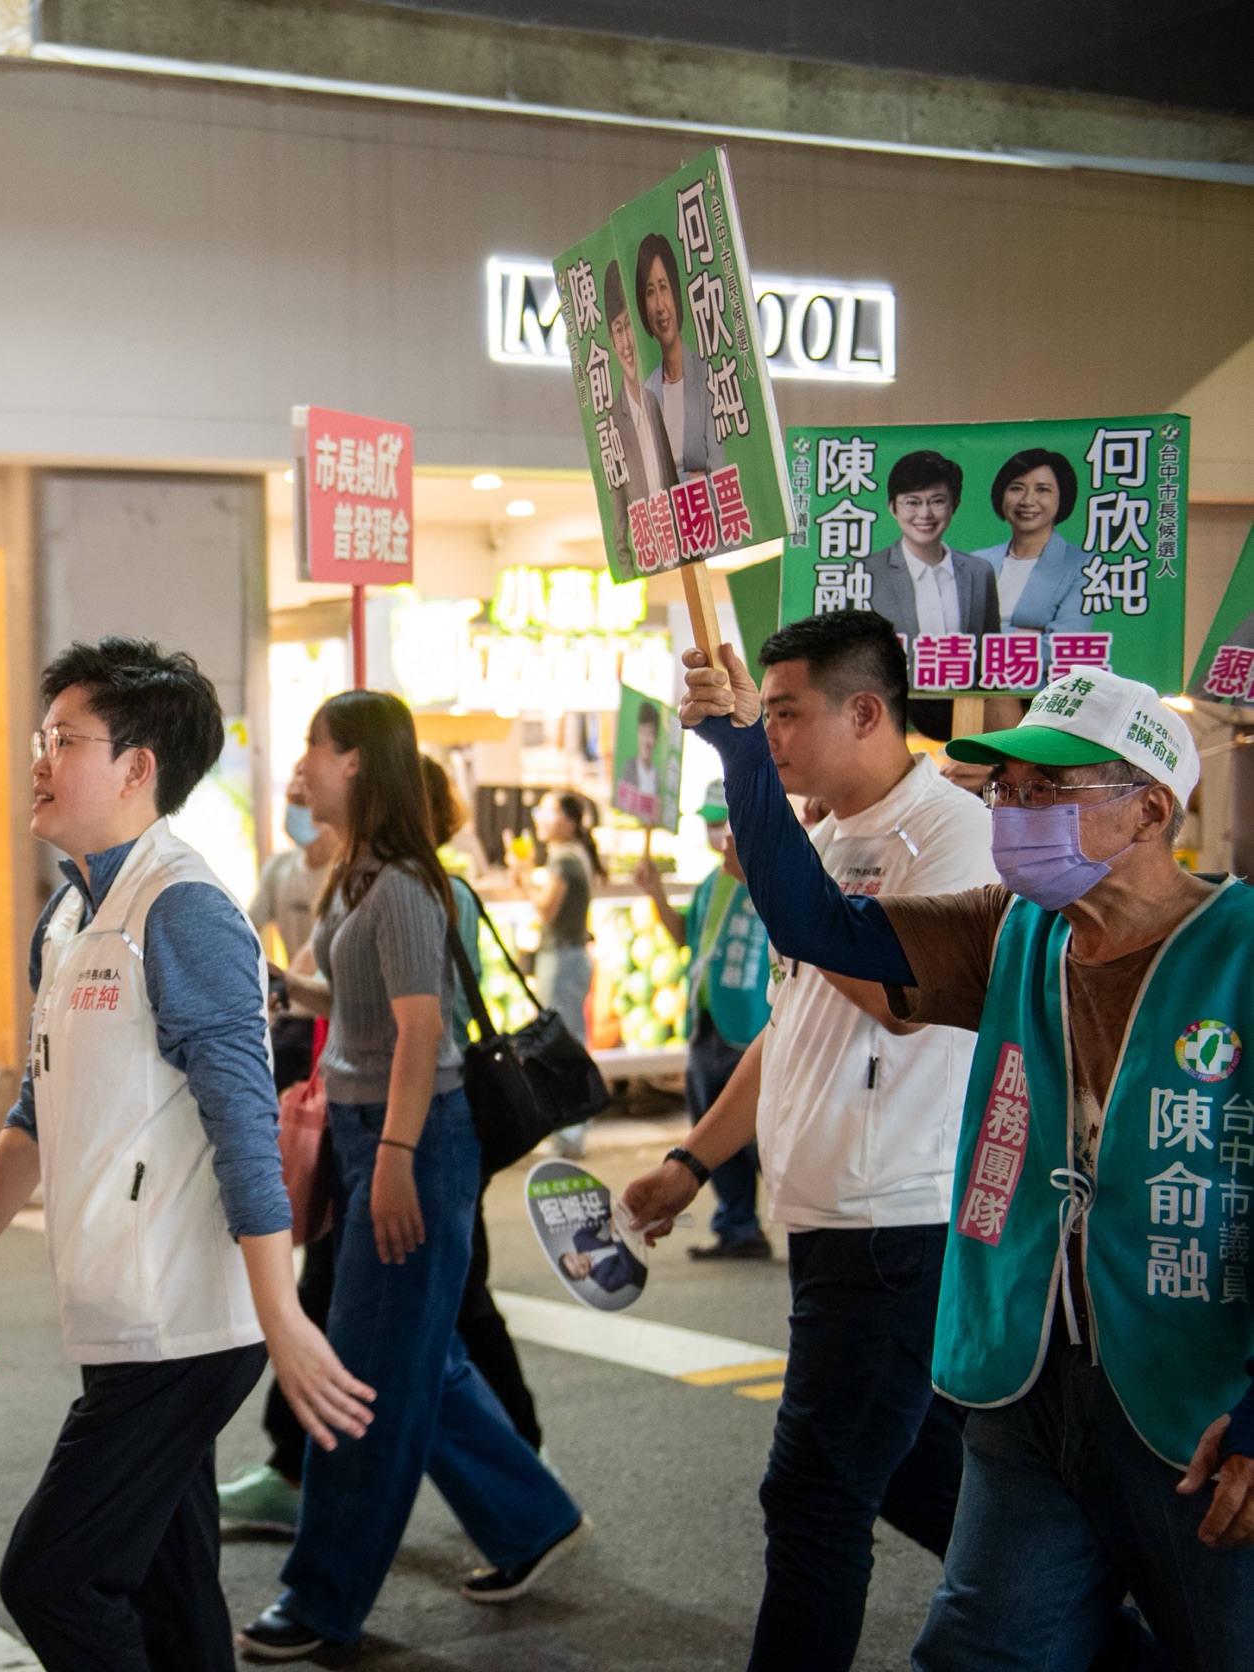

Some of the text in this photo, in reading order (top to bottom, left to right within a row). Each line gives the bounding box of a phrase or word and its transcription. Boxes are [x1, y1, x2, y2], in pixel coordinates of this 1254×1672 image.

[567, 257, 630, 492] 陳俞融
[676, 179, 750, 443] 何欣純
[314, 432, 404, 500] 市長換欣
[333, 502, 410, 564] 普發現金
[628, 463, 752, 573] 懇請賜票
[814, 436, 878, 617] 陳俞融
[1082, 427, 1152, 615] 何欣純
[1156, 444, 1180, 579] 台中市長候選人
[898, 632, 1114, 691] 請賜票
[1204, 645, 1254, 702] 懇
[1134, 725, 1179, 774] 陳俞融
[959, 1048, 1030, 1238] 服務團隊
[1145, 1086, 1214, 1303] 陳俞融
[1218, 1092, 1254, 1306] 台中市議員
